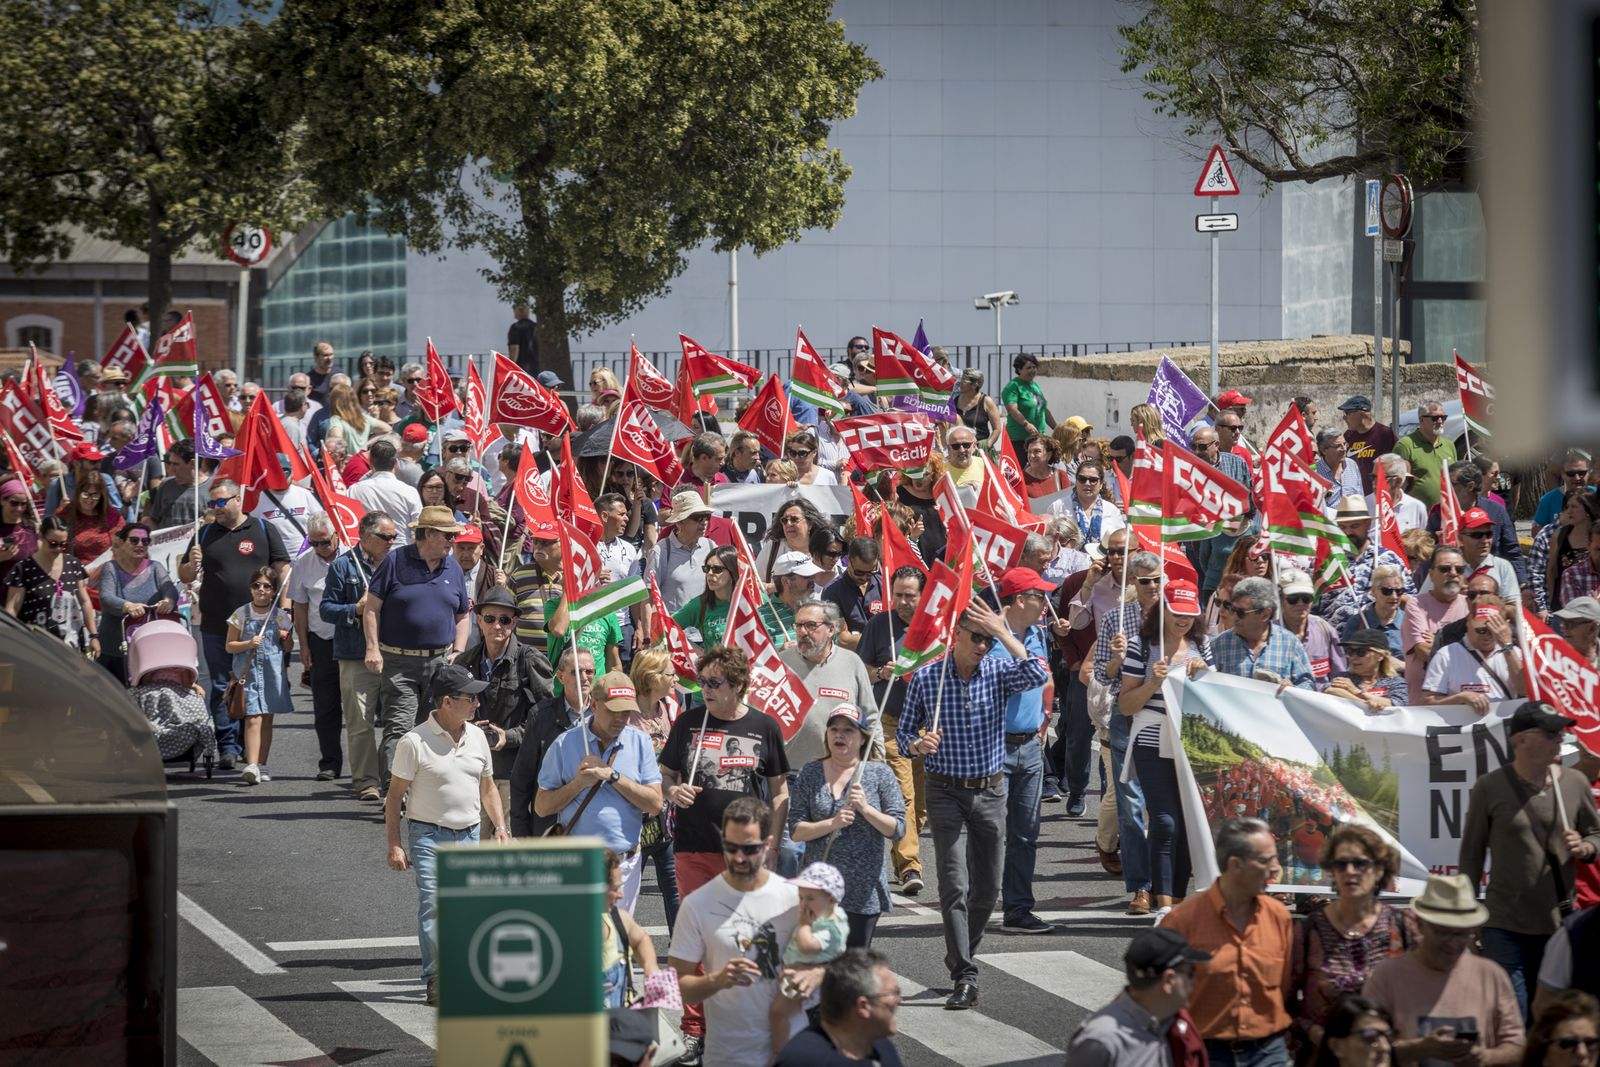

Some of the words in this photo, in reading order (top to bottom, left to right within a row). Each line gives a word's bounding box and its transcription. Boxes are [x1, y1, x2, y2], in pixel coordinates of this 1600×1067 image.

[233, 232, 261, 248] 40
[1351, 441, 1366, 449] JUST
[890, 446, 928, 462] Cádiz
[1173, 456, 1243, 521] CCOO
[1544, 641, 1600, 705] UGT
[820, 689, 843, 697] CCOO
[751, 675, 796, 728] ádiz
[721, 757, 747, 765] CCOO
